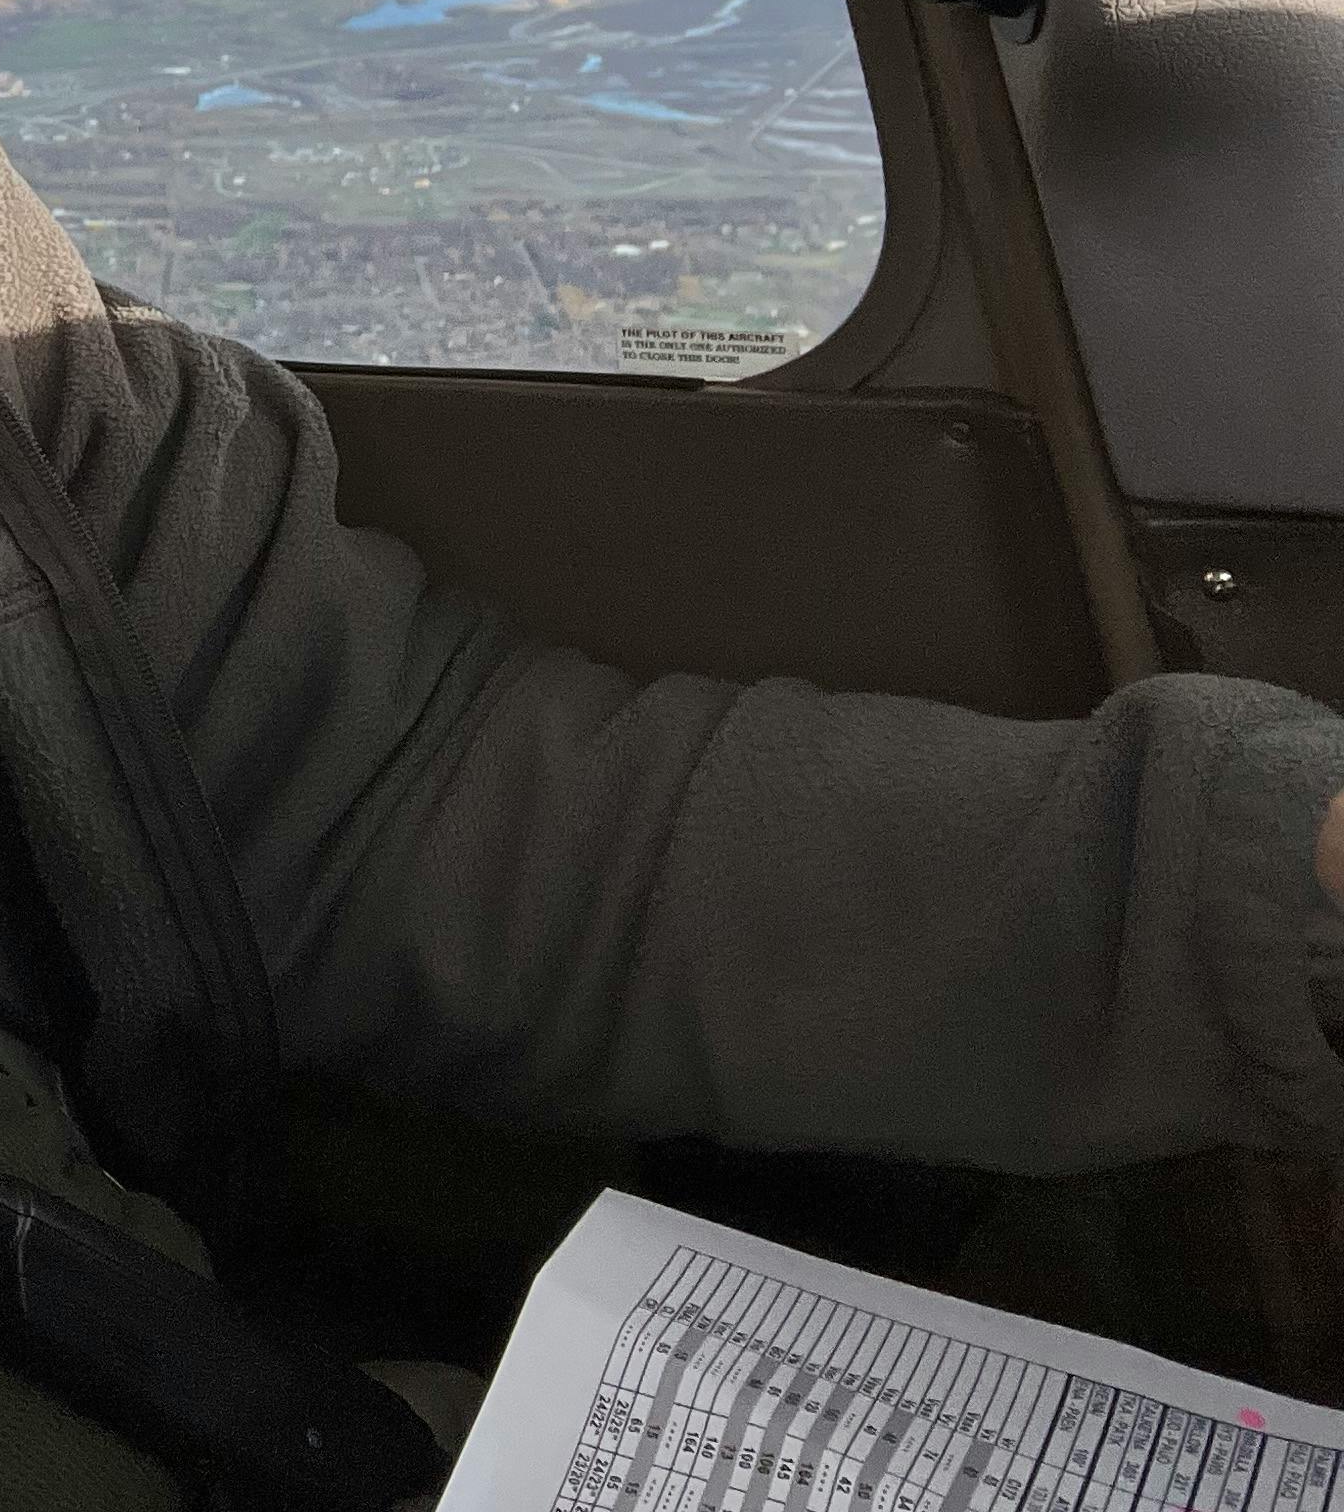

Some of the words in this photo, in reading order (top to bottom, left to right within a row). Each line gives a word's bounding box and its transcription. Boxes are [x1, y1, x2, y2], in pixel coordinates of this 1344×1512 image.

[621, 328, 643, 338] THE
[646, 329, 678, 339] PILOT
[681, 331, 696, 340] OF
[701, 331, 725, 341] THIS
[728, 333, 785, 343] AIRCRAFT
[634, 341, 656, 349] THE
[659, 341, 687, 351] ONLY
[715, 345, 786, 355] AUTHORIZED
[623, 351, 637, 360] TO
[639, 352, 674, 361] CLOSE
[678, 354, 703, 362] THIS
[627, 1417, 644, 1434] 65
[646, 1424, 662, 1439] 15
[682, 1430, 700, 1454] 164
[701, 1437, 719, 1459] 140
[738, 1447, 756, 1470] 100
[776, 1457, 794, 1481] 145
[607, 1475, 622, 1489] 65
[625, 1482, 640, 1495] 15
[836, 1475, 853, 1495] 42
